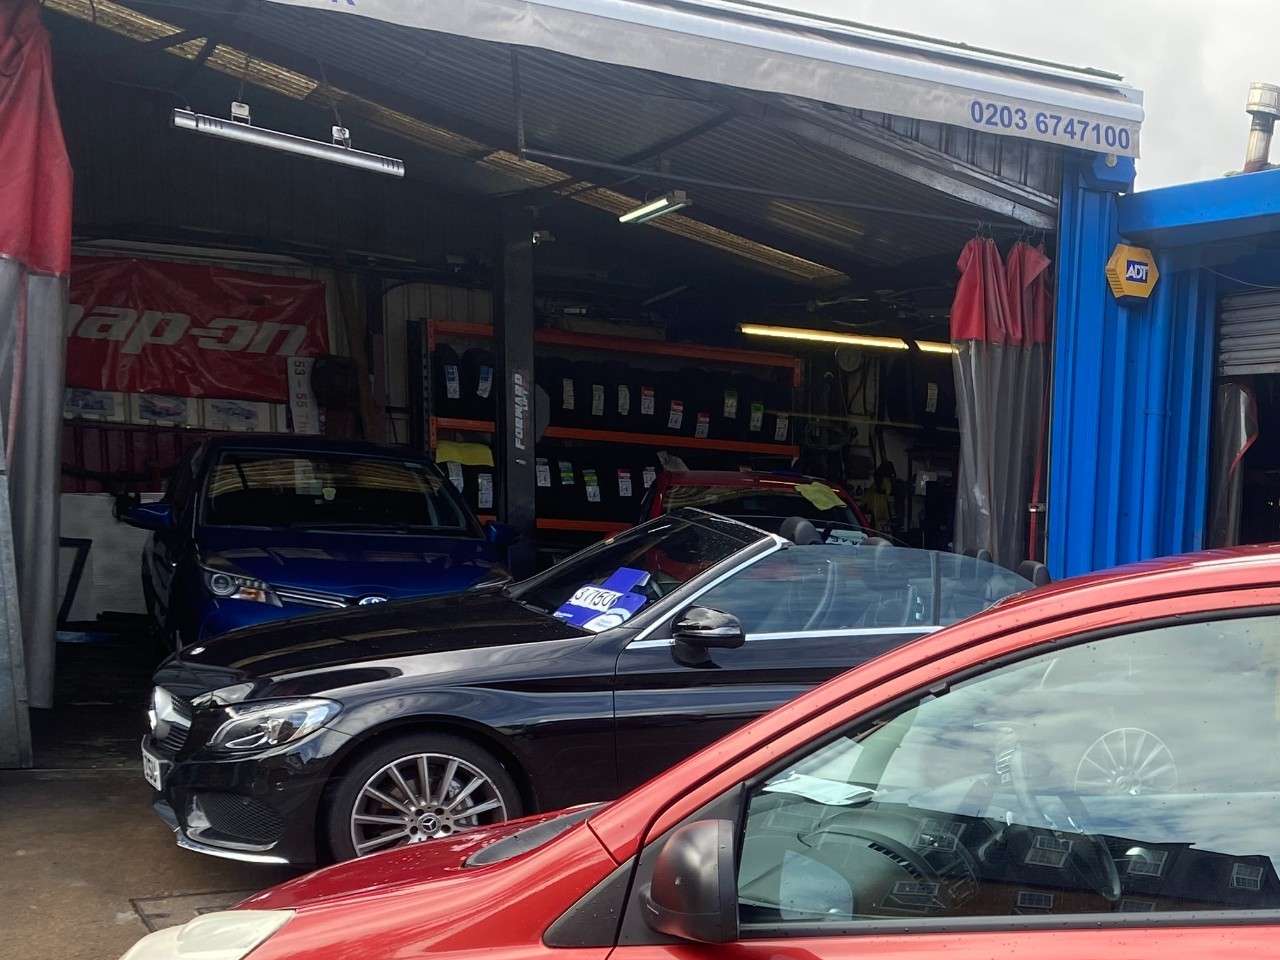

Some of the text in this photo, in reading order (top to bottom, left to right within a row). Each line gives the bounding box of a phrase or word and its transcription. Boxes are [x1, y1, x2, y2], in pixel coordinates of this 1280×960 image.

[971, 100, 1130, 149] 0203 6747100
[1126, 263, 1149, 281] ADT
